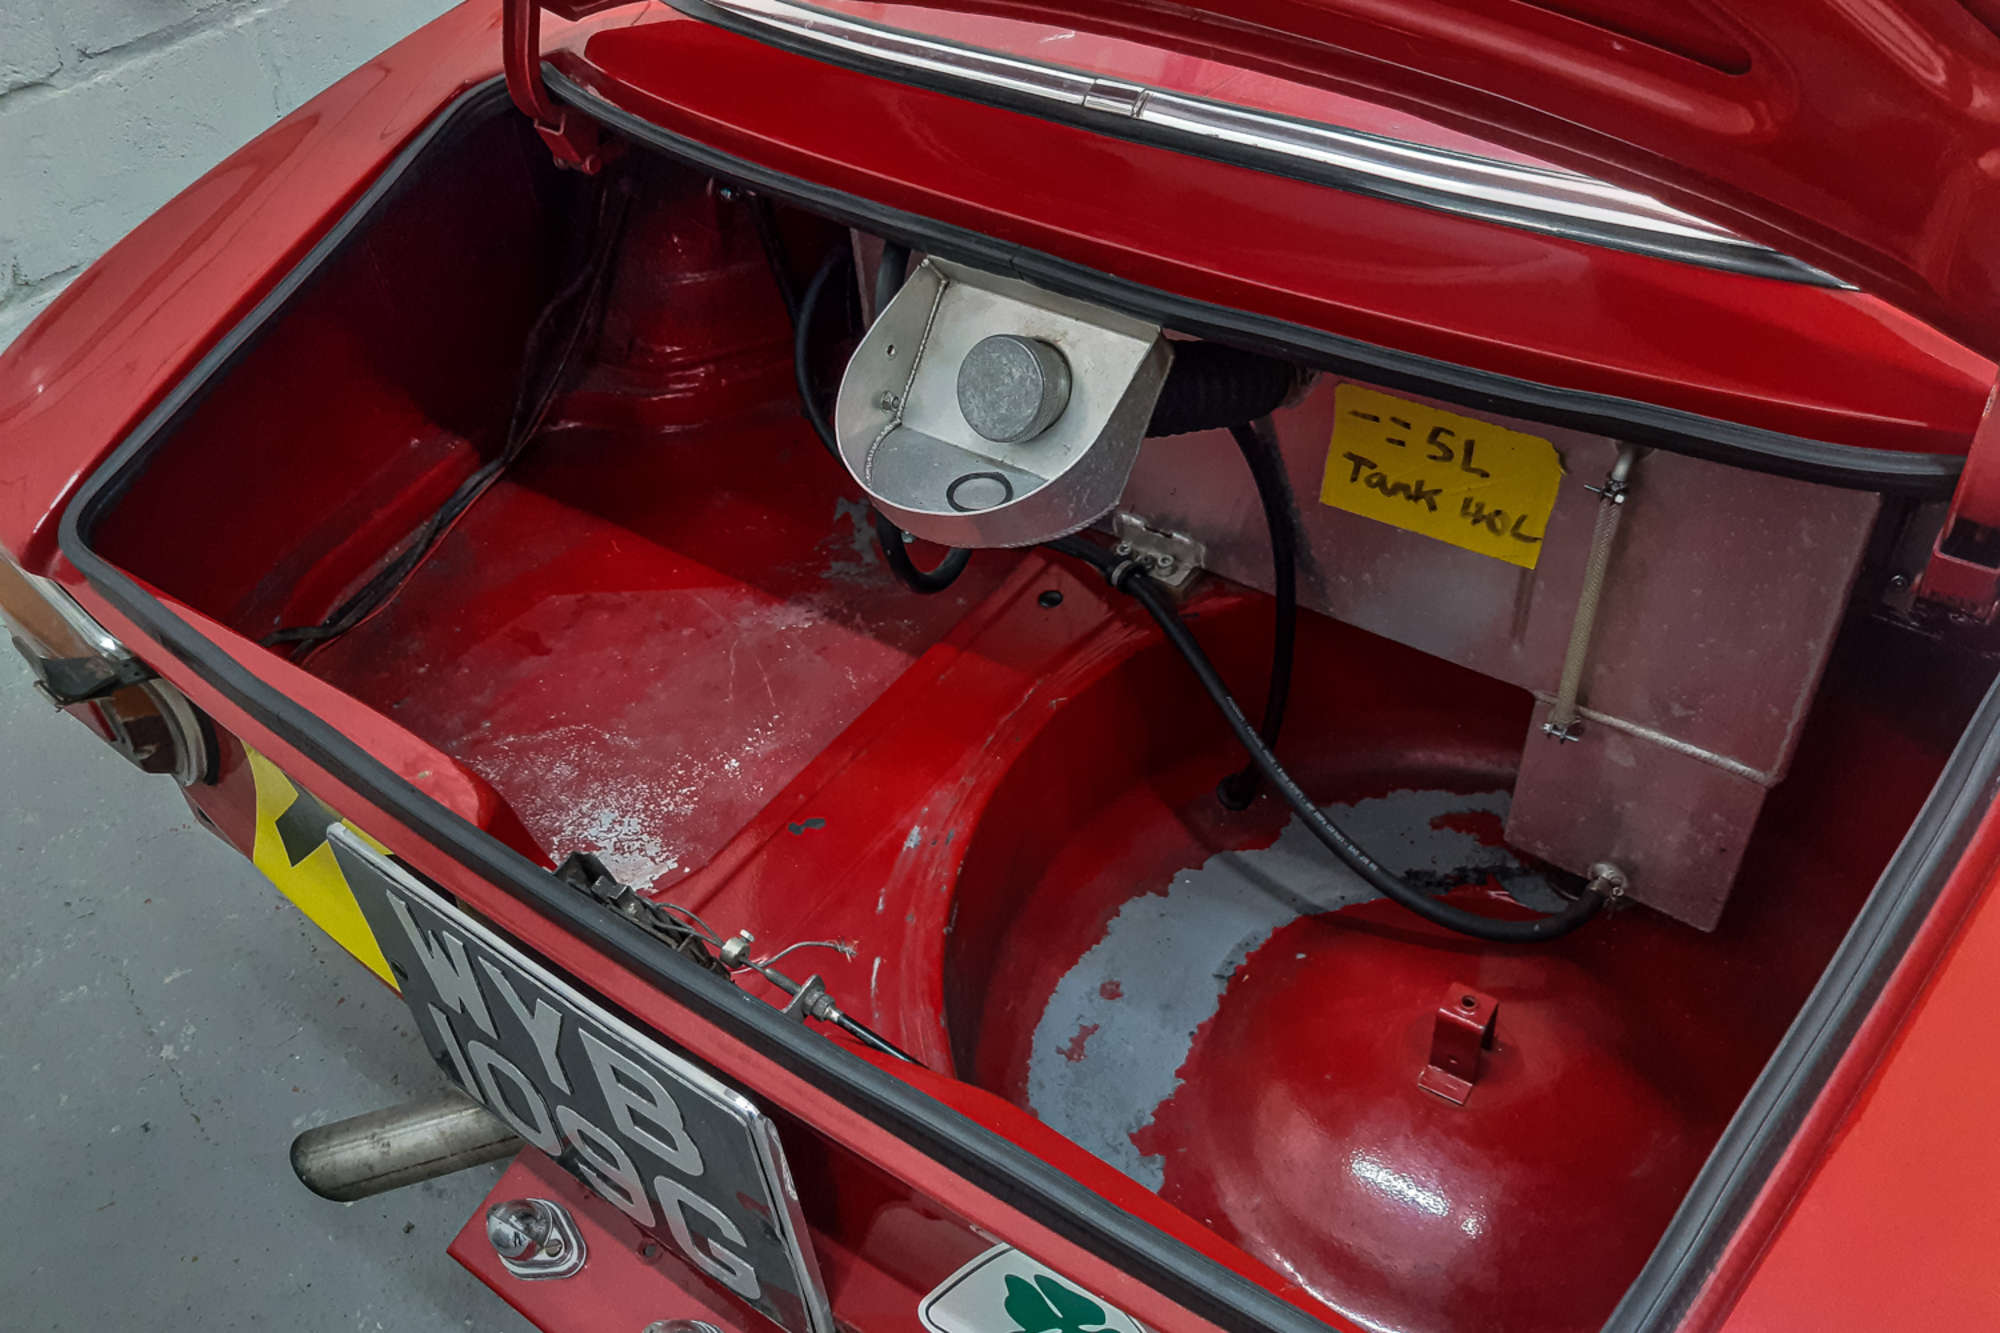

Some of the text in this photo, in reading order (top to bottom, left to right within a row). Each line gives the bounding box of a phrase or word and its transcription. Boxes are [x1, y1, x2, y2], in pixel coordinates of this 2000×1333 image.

[1342, 451, 1543, 543] Tank 40L
[386, 889, 704, 1177] WYB
[428, 1003, 761, 1300] 109G
